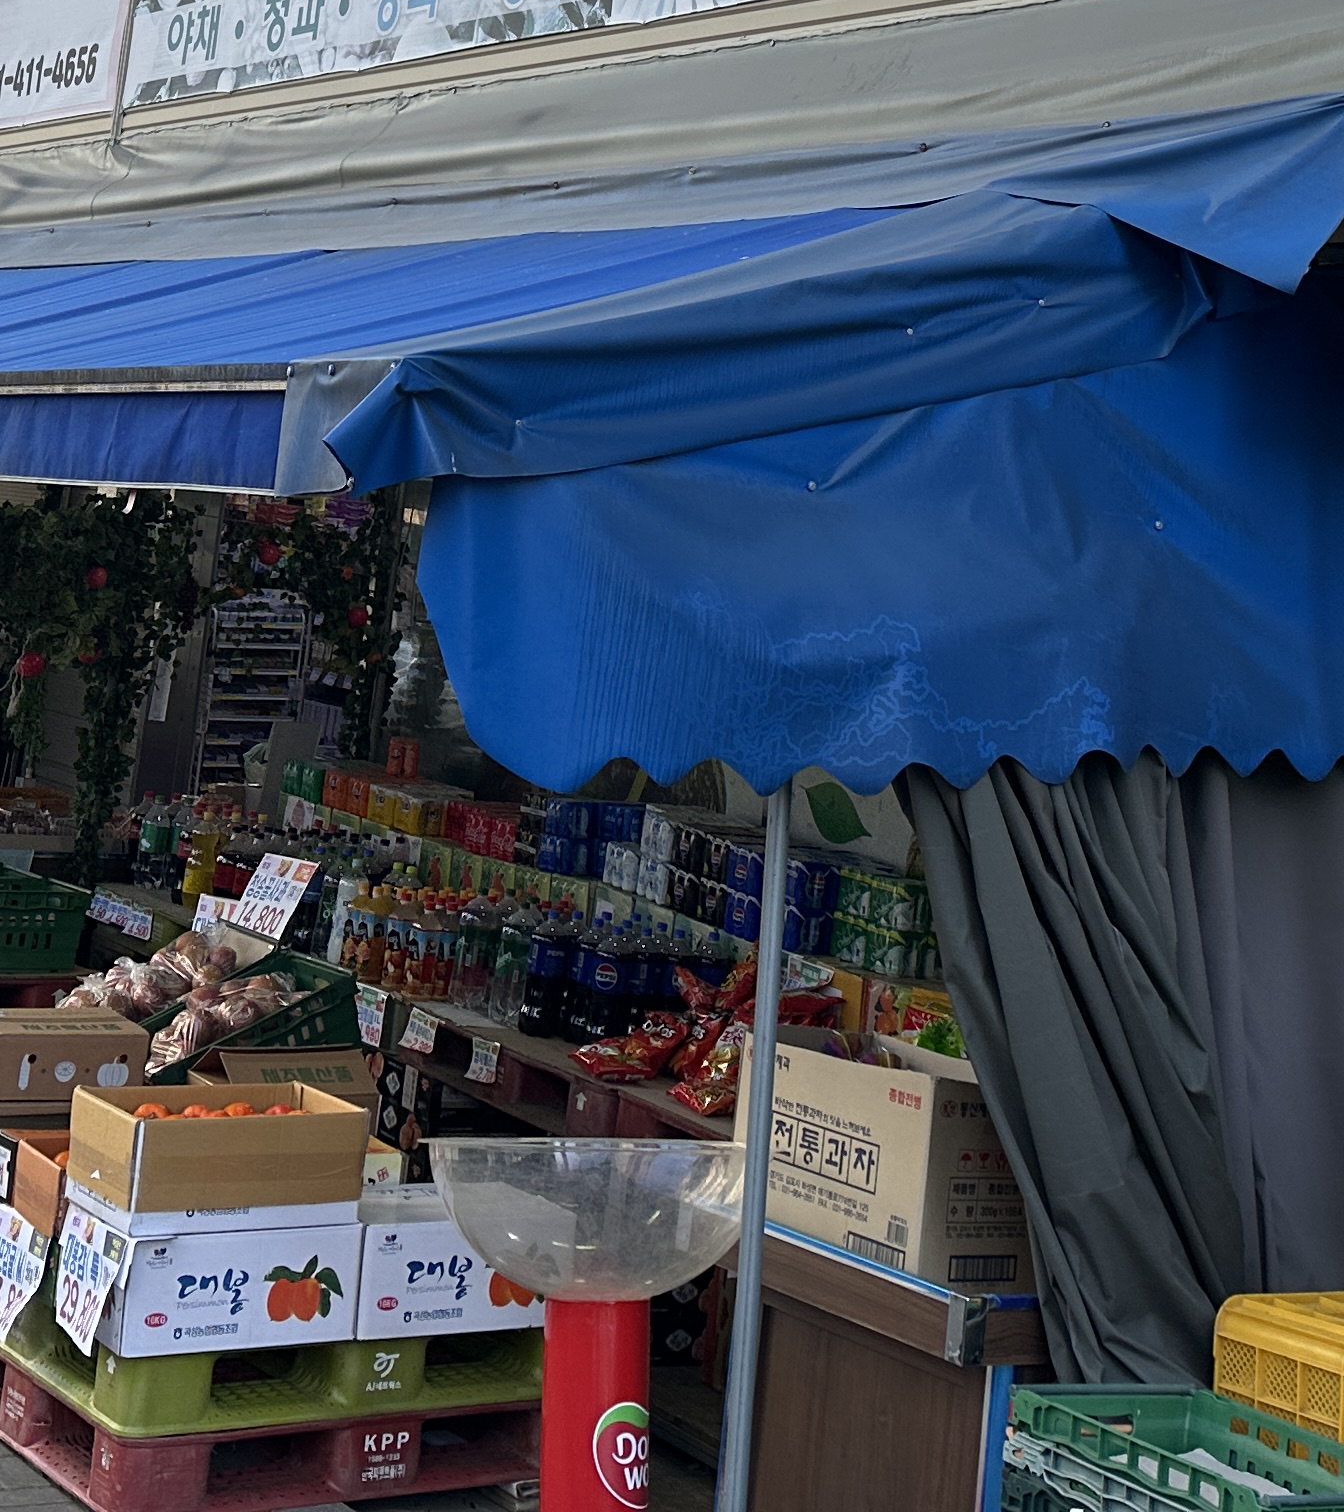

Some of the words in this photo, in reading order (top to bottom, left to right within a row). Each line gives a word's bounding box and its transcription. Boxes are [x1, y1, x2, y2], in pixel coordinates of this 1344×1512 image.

[167, 5, 223, 67] 야채
[774, 1120, 875, 1186] 전통과자
[364, 1432, 410, 1452] KPP
